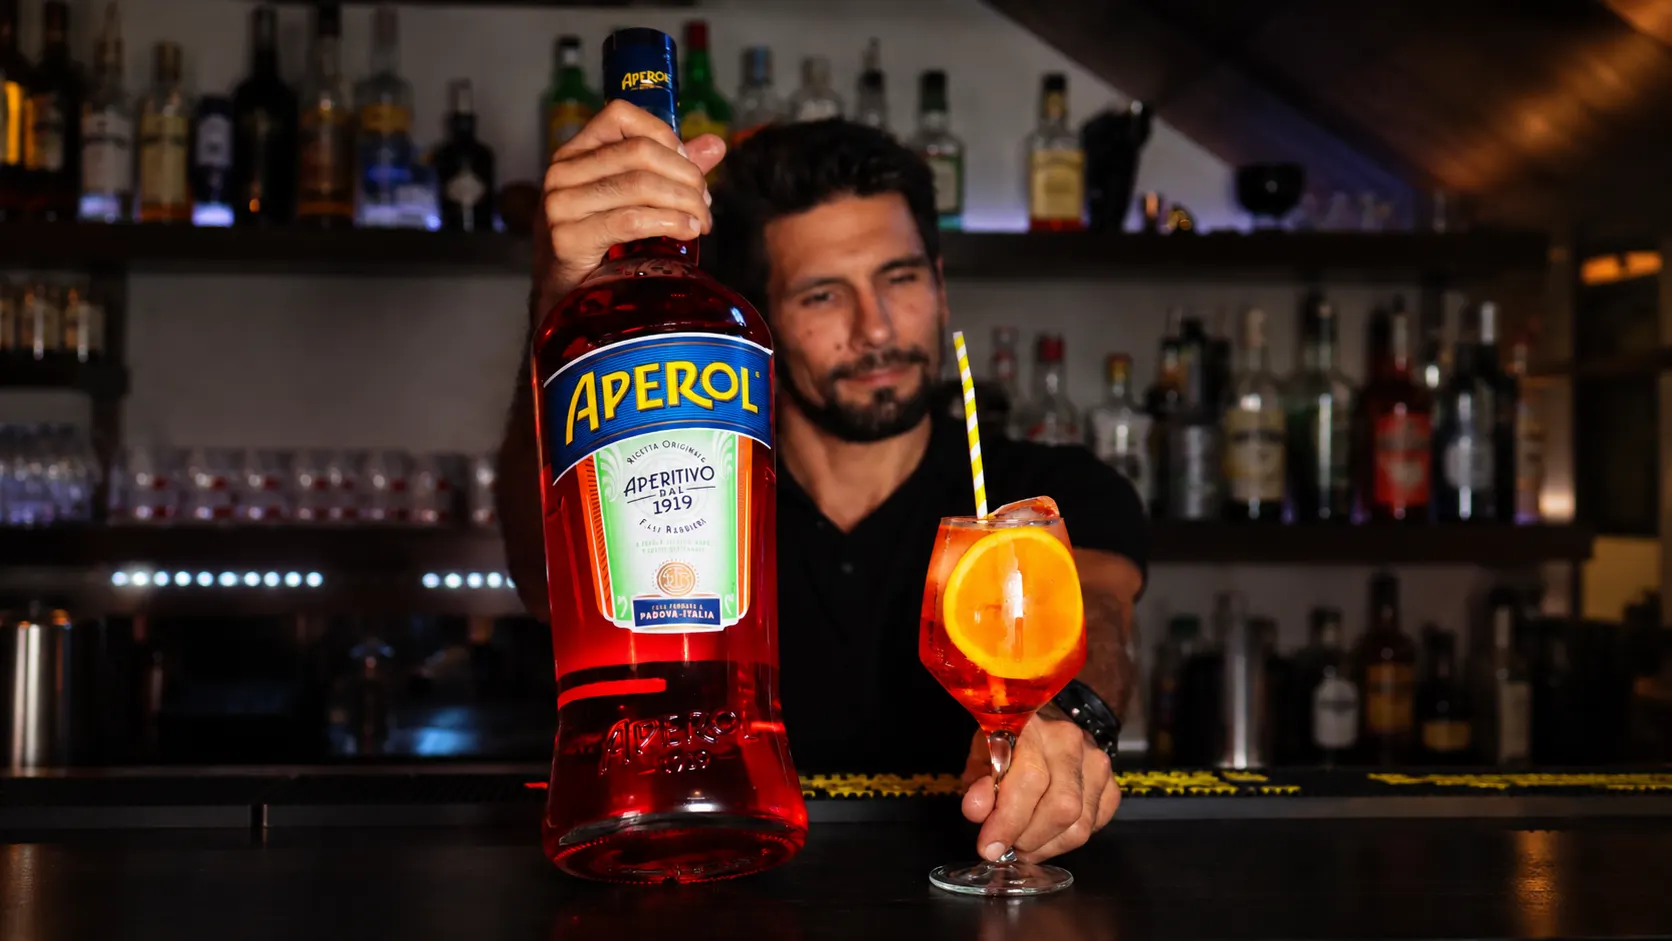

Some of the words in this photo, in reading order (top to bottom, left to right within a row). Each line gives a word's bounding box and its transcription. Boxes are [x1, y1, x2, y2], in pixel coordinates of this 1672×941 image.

[565, 359, 760, 446] APEROL
[626, 443, 659, 465] RICETTA
[623, 465, 715, 497] APERITIVO
[660, 486, 685, 498] DAL
[653, 495, 693, 515] 1919
[639, 609, 715, 621] PADOVA-ITALIA
[598, 710, 760, 776] APEROL
